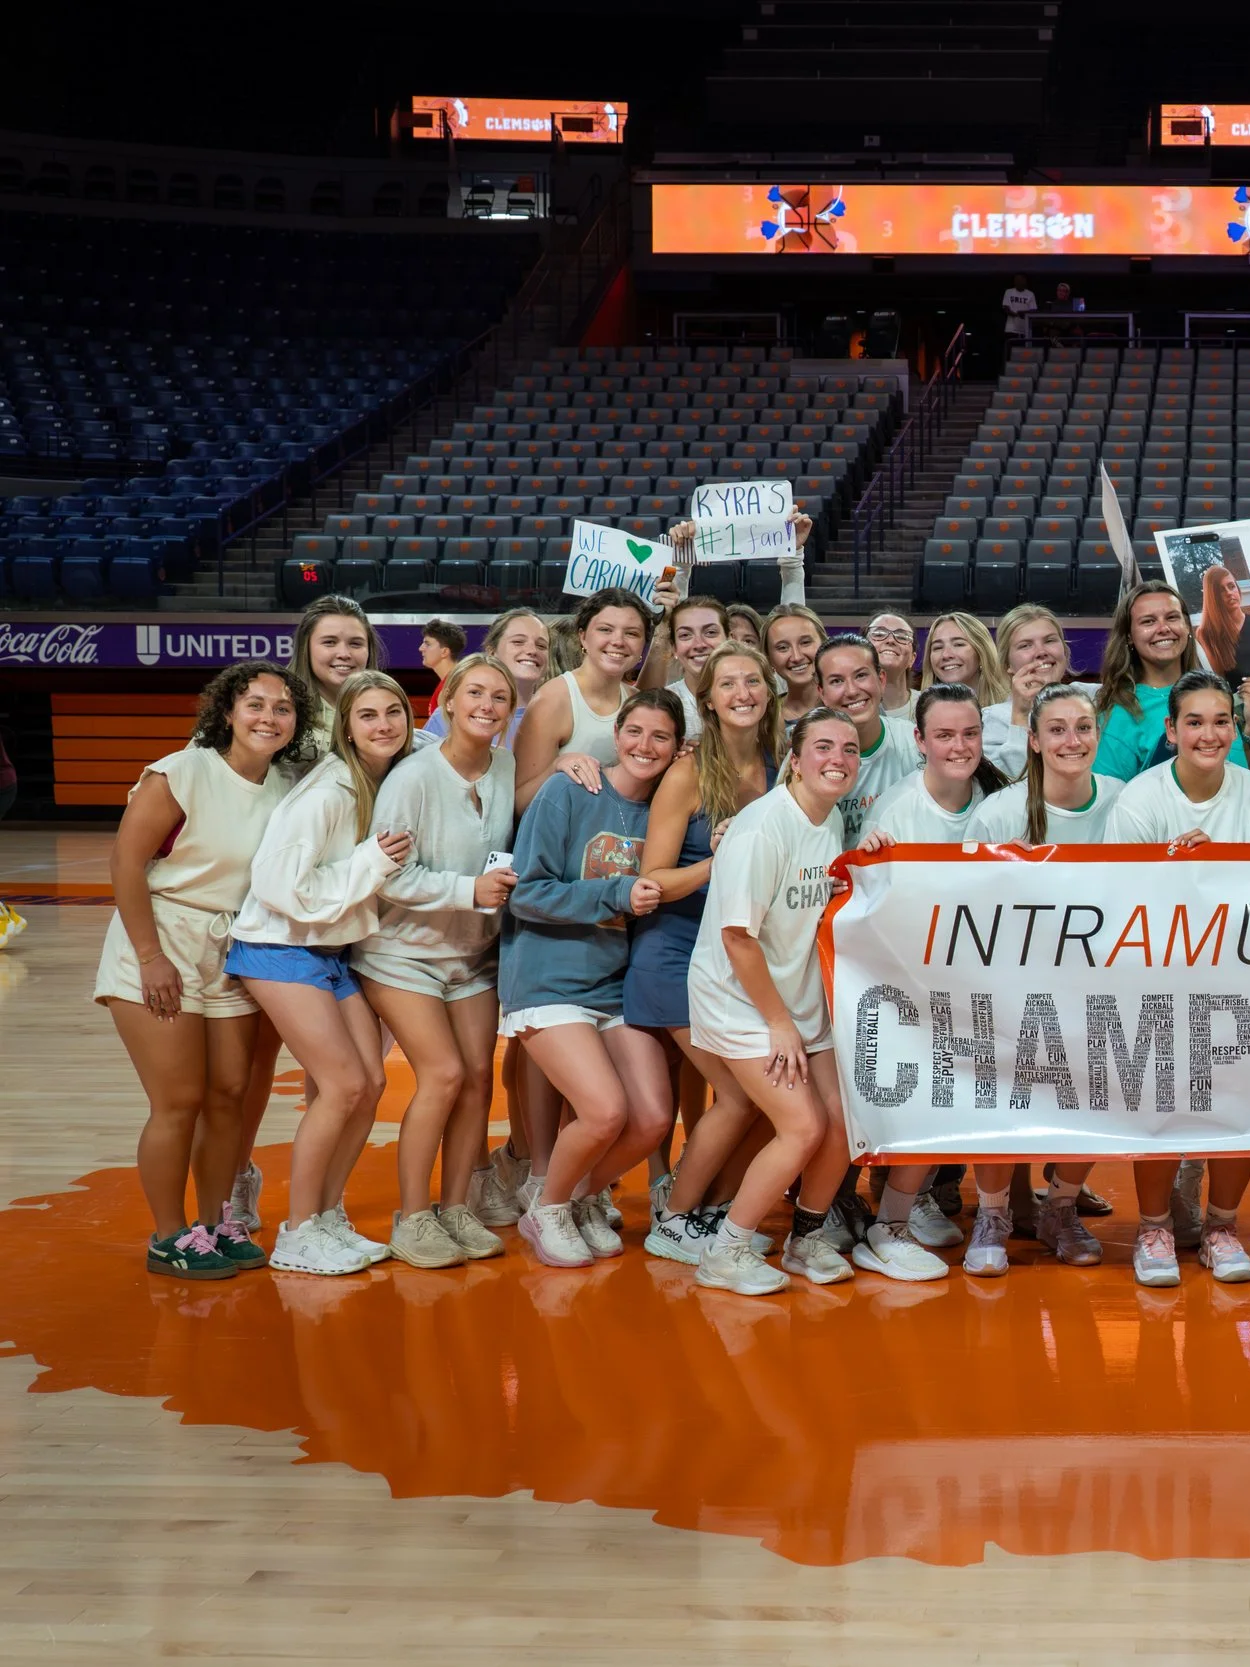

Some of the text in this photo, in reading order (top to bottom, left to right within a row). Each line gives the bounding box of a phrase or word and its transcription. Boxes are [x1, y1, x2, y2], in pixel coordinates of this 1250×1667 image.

[696, 483, 785, 517] KYRA'S
[578, 525, 612, 554] WE
[694, 519, 792, 556] #1 fan!
[166, 634, 271, 657] UNITED
[899, 1007, 919, 1017] FLAG
[931, 1006, 951, 1014] FLAG
[978, 1001, 986, 1014] FUN
[1020, 1030, 1038, 1038] PLAY
[866, 1011, 878, 1071] VOLLEYBALL
[940, 1036, 974, 1045] SPIKEBALL
[1212, 1046, 1250, 1055] RESPECT
[975, 1055, 995, 1064] FLAG
[1048, 1052, 1066, 1061] FUN
[933, 1051, 941, 1084] RESPECT
[942, 1051, 953, 1076] PLAY
[1015, 1071, 1056, 1079] BATTLESHIP
[976, 1081, 990, 1089] FUN
[1094, 1066, 1103, 1098] SPIKEBALL
[1190, 1080, 1211, 1090] FUN
[1010, 1100, 1030, 1109] PLAY
[657, 1223, 684, 1244] HOKA
